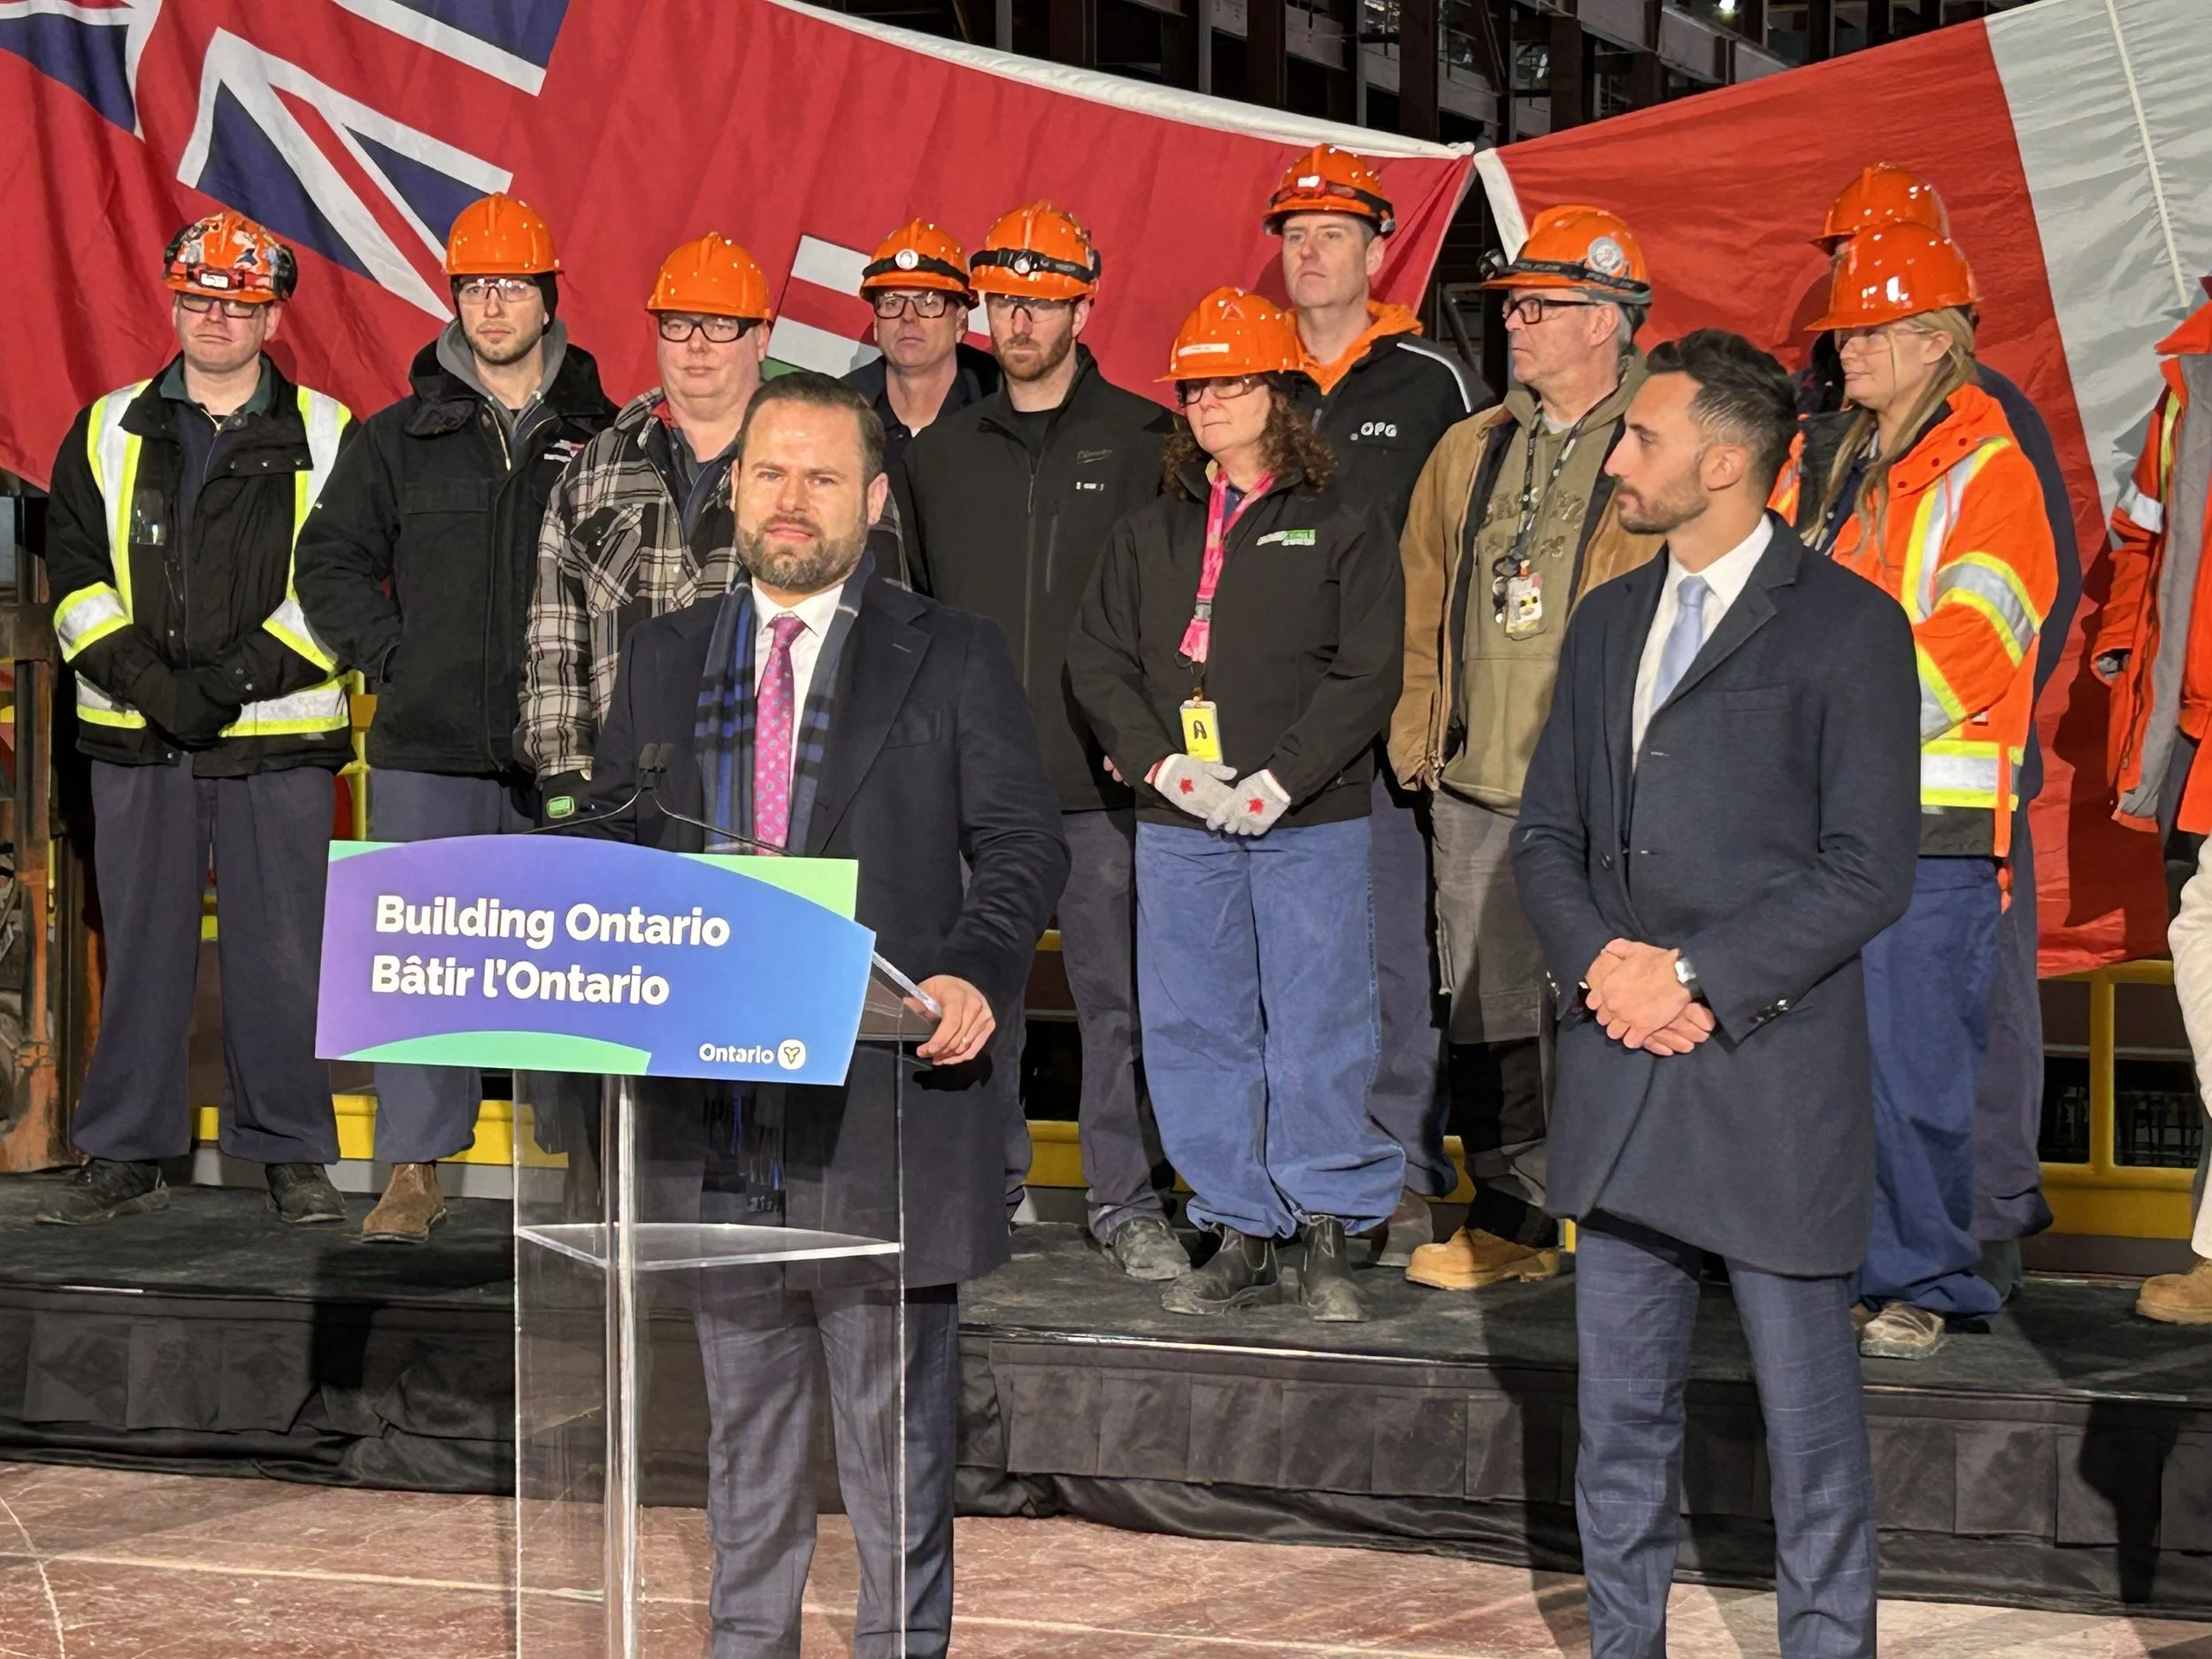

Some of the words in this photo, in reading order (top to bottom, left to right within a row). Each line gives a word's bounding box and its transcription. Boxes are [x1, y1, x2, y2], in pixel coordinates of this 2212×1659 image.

[1360, 421, 1397, 438] OPG
[1193, 719, 1208, 740] A
[375, 895, 555, 950] Building
[565, 902, 731, 947] Ontario
[372, 955, 475, 997] Bâtir
[482, 958, 670, 1006] l'Ontario
[698, 1042, 775, 1064] Ontario
